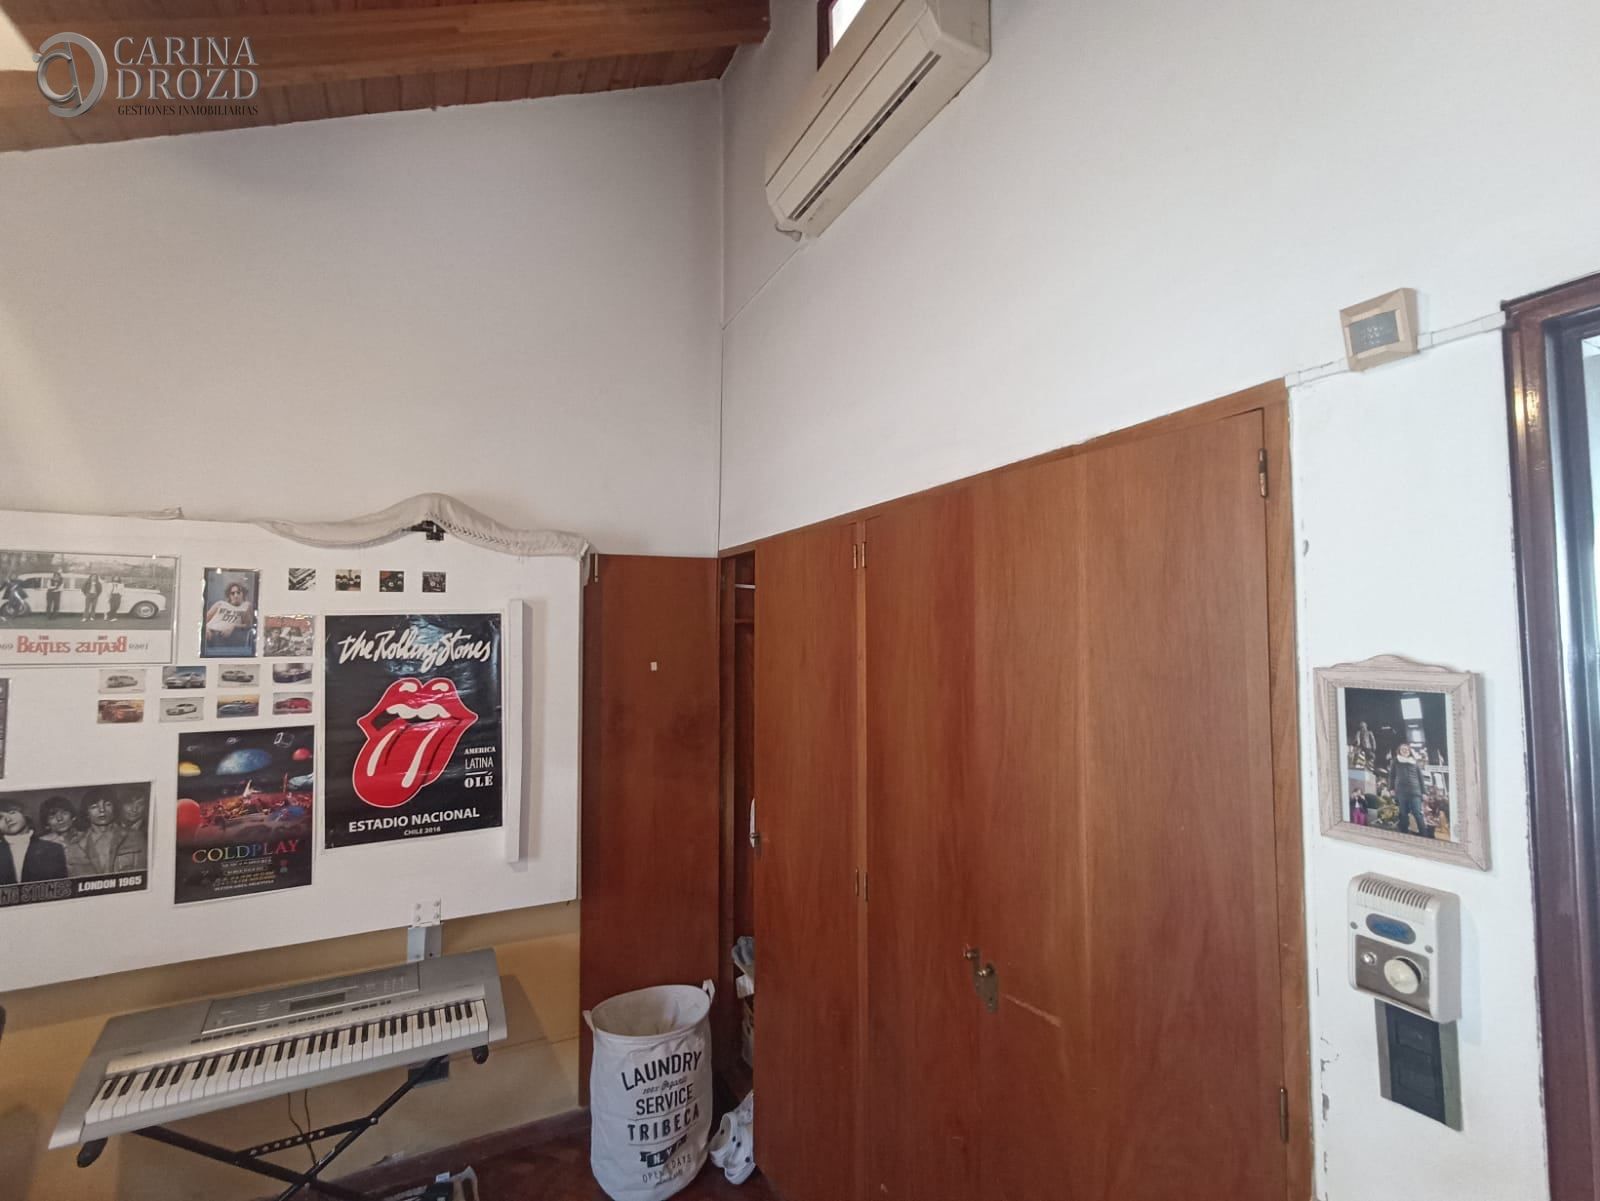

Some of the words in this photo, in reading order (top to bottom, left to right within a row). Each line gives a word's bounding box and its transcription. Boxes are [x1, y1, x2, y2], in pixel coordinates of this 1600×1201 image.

[337, 630, 374, 664] the
[372, 624, 440, 673] Rolling
[435, 629, 491, 666] Stones
[464, 746, 496, 754] AMERICA
[464, 757, 494, 770] LATINA
[464, 772, 494, 788] OLÉ
[349, 816, 409, 833] ESTADIO
[411, 807, 480, 827] NACIONAL
[403, 828, 423, 836] CHILE
[424, 826, 441, 834] 2016
[191, 840, 299, 864] COLDPLAY
[78, 879, 117, 892] LONDON
[118, 875, 143, 888] 1965
[621, 1051, 703, 1091] LAUNDRY
[635, 1083, 694, 1116] SERVICE
[627, 1106, 700, 1141] TRIBECA
